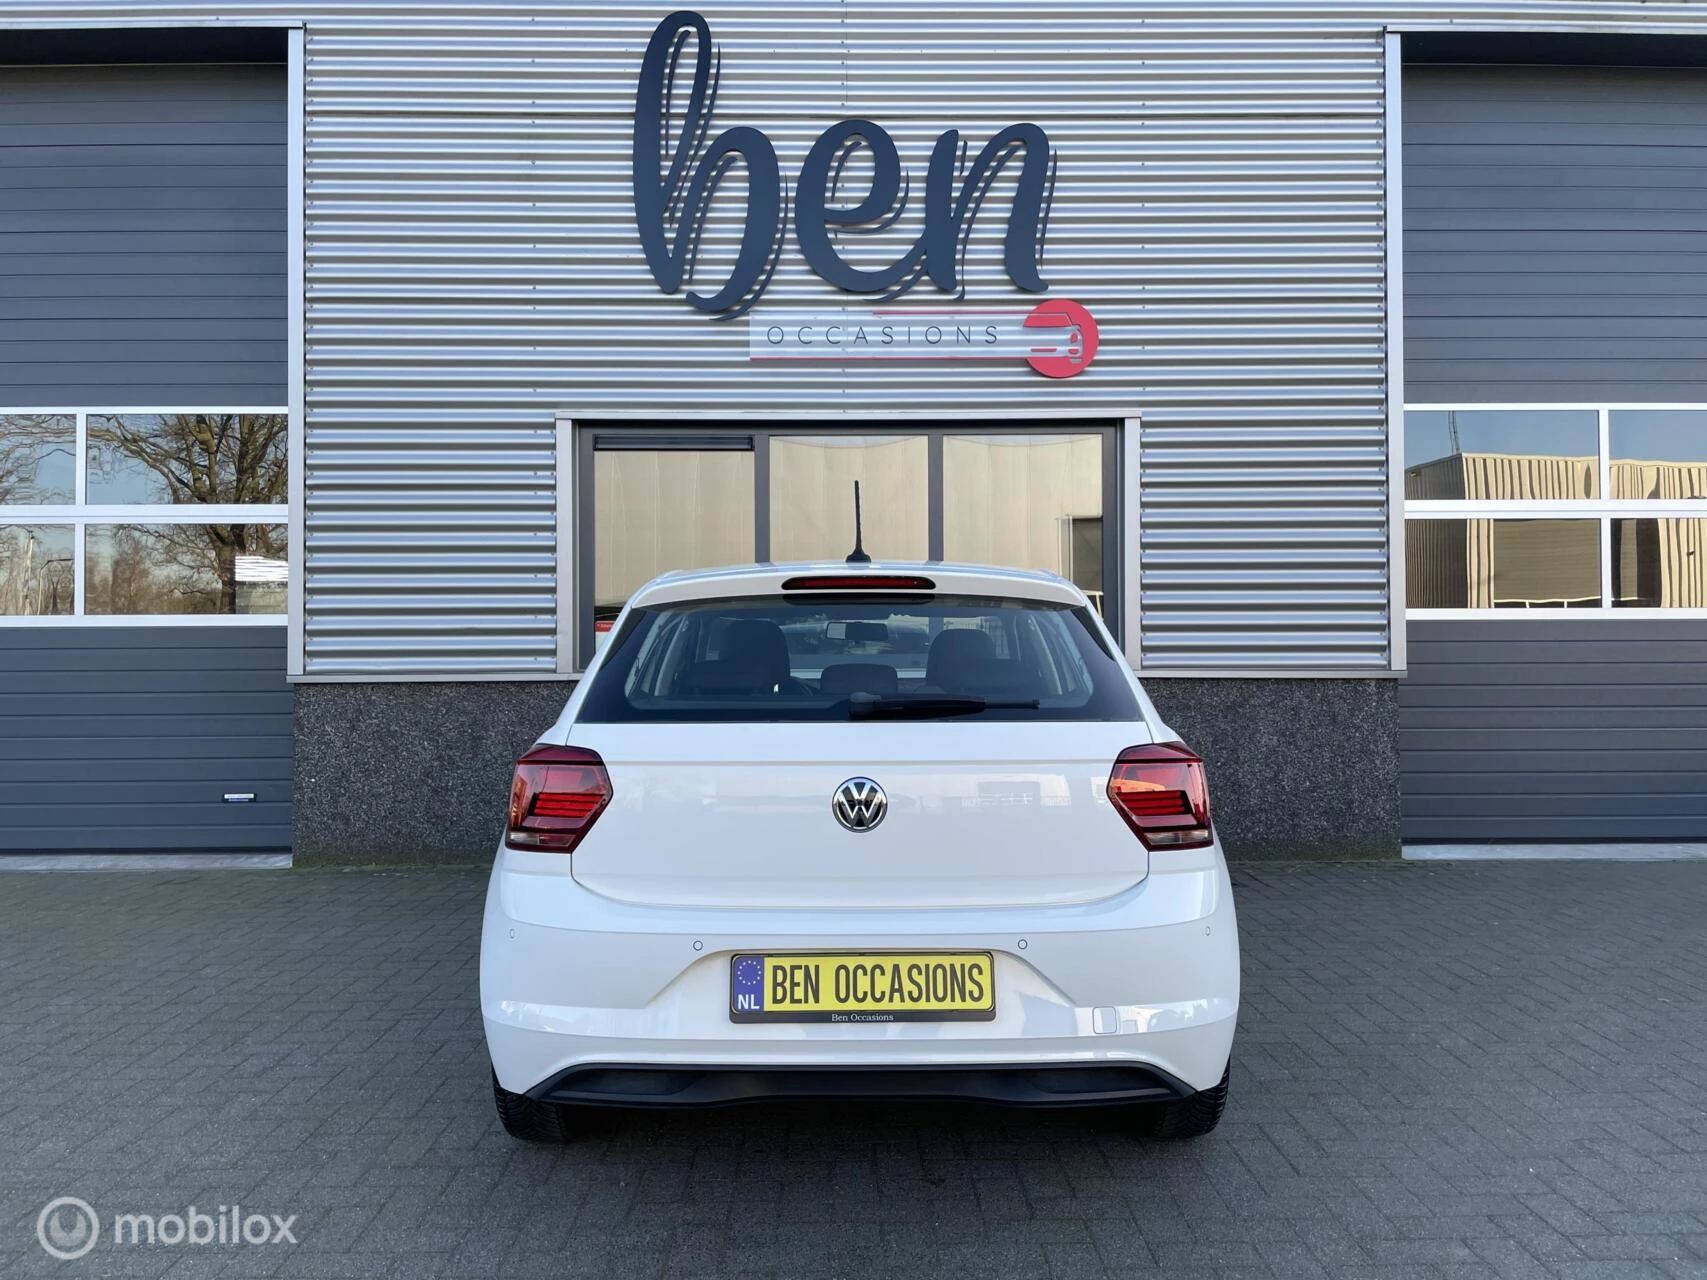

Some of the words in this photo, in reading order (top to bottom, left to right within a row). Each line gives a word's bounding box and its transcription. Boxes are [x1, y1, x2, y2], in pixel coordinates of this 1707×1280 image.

[633, 10, 1052, 315] ben
[767, 326, 998, 345] OCCASIONS
[833, 777, 887, 832] VW
[772, 964, 820, 1004] BEN
[834, 963, 984, 1004] OCCASIONS
[737, 994, 760, 1010] NL
[831, 1013, 849, 1022] Ben
[850, 1013, 894, 1022] Occasions
